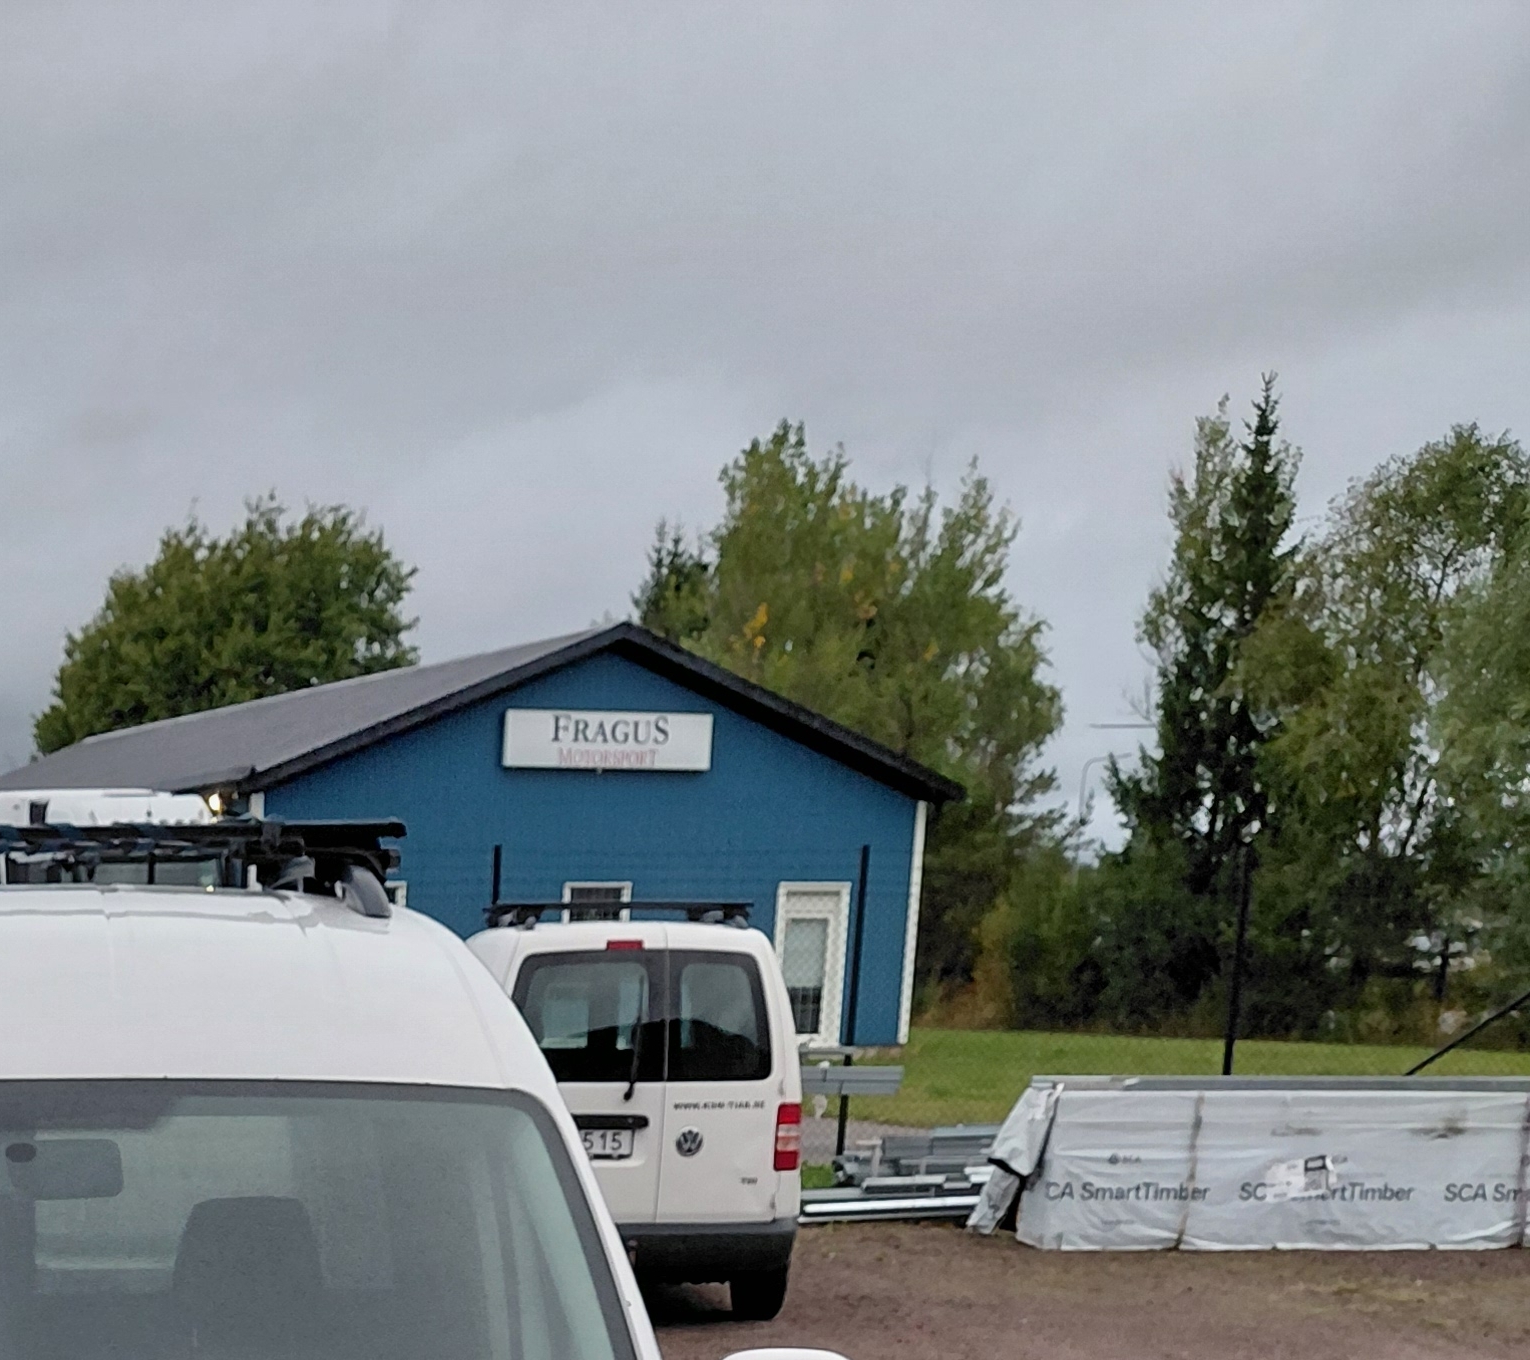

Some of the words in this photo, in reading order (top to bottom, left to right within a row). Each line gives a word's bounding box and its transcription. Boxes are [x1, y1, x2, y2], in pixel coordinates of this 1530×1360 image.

[551, 714, 670, 745] FRAGUS
[558, 747, 659, 767] MOTORSPORT
[582, 1131, 622, 1150] 515
[1080, 1181, 1210, 1201] SmartTimber
[1444, 1183, 1487, 1202] SCA
